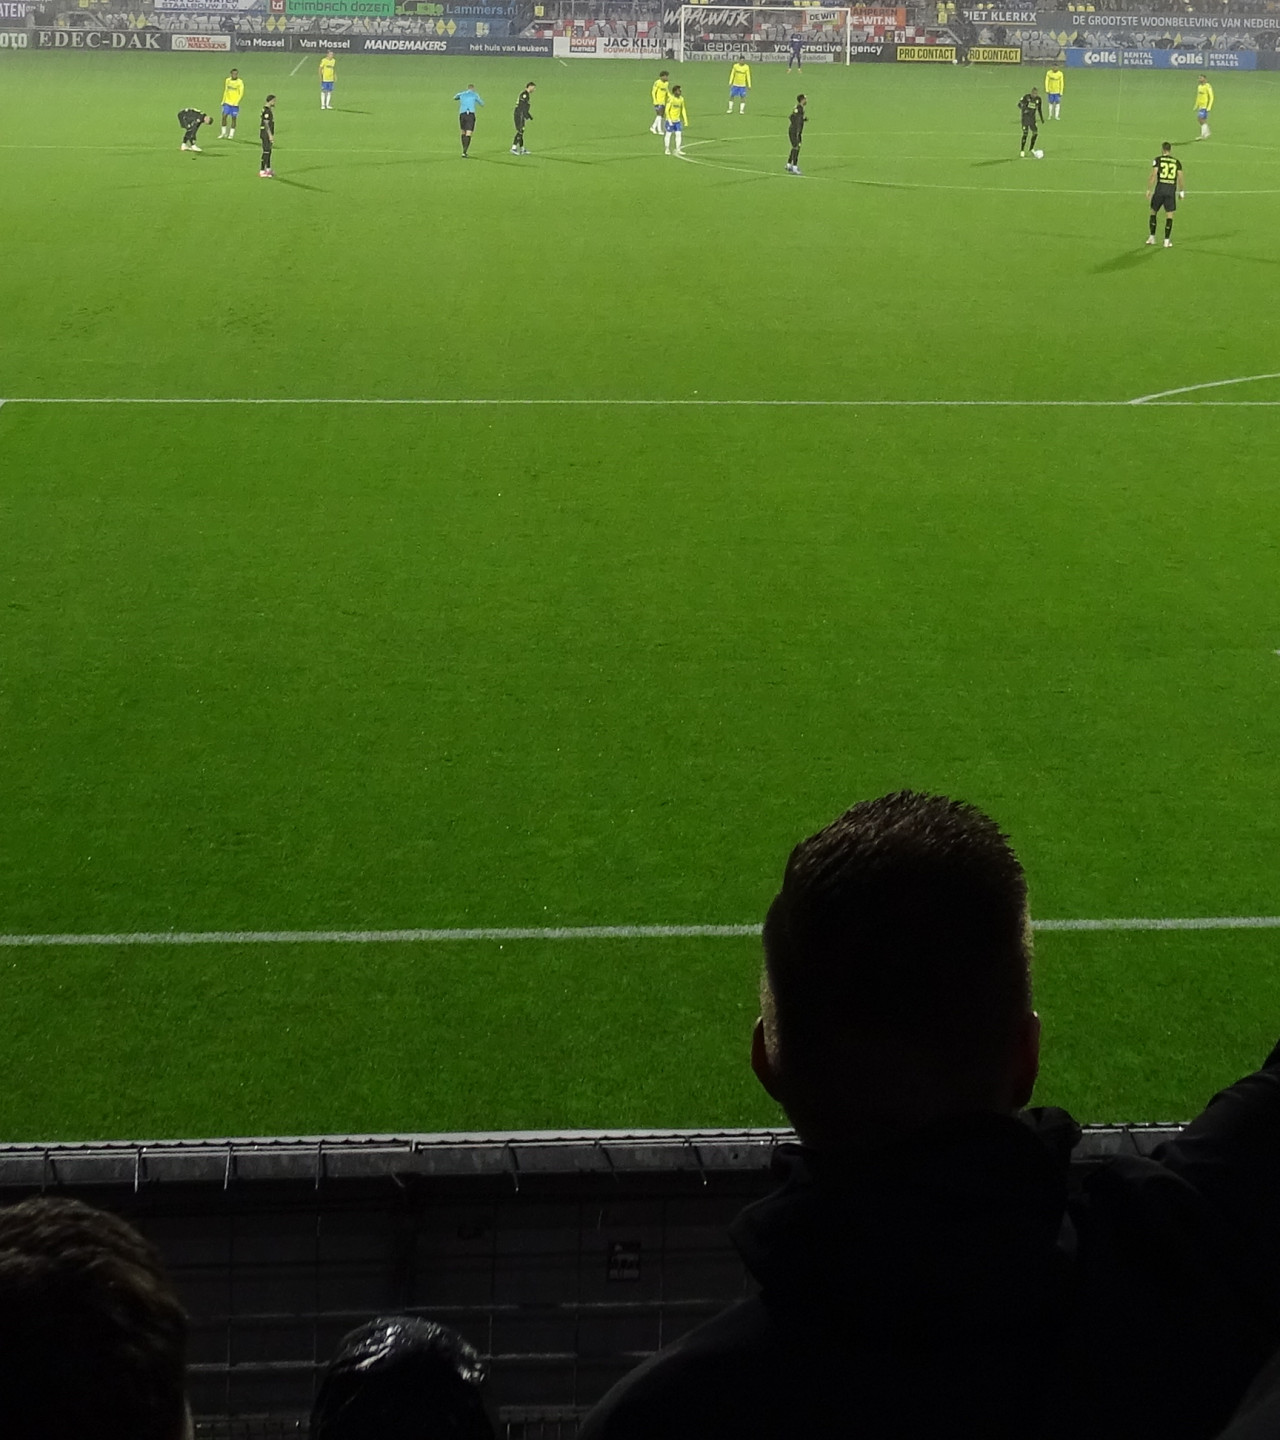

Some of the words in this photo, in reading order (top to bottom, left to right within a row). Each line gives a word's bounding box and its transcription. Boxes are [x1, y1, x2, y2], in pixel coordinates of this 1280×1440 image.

[288, 0, 347, 12] trimbach
[351, 1, 390, 13] dozen
[446, 3, 518, 16] Lammers.nl
[664, 8, 751, 27] WAALWIJK
[963, 10, 988, 21] PIET
[991, 11, 1037, 22] KLERKX
[1073, 16, 1086, 25] DE
[1088, 16, 1139, 26] GROOTSTE
[1141, 17, 1219, 28] WOONBELEVING
[1221, 18, 1241, 28] VAN
[39, 31, 161, 50] EDEC-DAK
[235, 38, 251, 47] Van
[253, 38, 285, 47] Mossel
[300, 39, 318, 48] Van
[320, 39, 350, 49] Mossel
[364, 40, 447, 52] MANDEMAKERS
[484, 43, 499, 52] huis
[517, 44, 549, 52] keukens
[571, 38, 595, 46] BOUW
[604, 38, 629, 47] JAC
[632, 38, 667, 48] KLIJN
[899, 47, 915, 59] PRO
[917, 48, 954, 60] CONTACT
[982, 49, 1019, 61] CONTACT
[1084, 51, 1117, 64] Collé
[1171, 53, 1203, 66] Collé
[1209, 53, 1239, 61] RENTAL
[1129, 58, 1153, 66] SALES
[1160, 162, 1177, 179] 33
